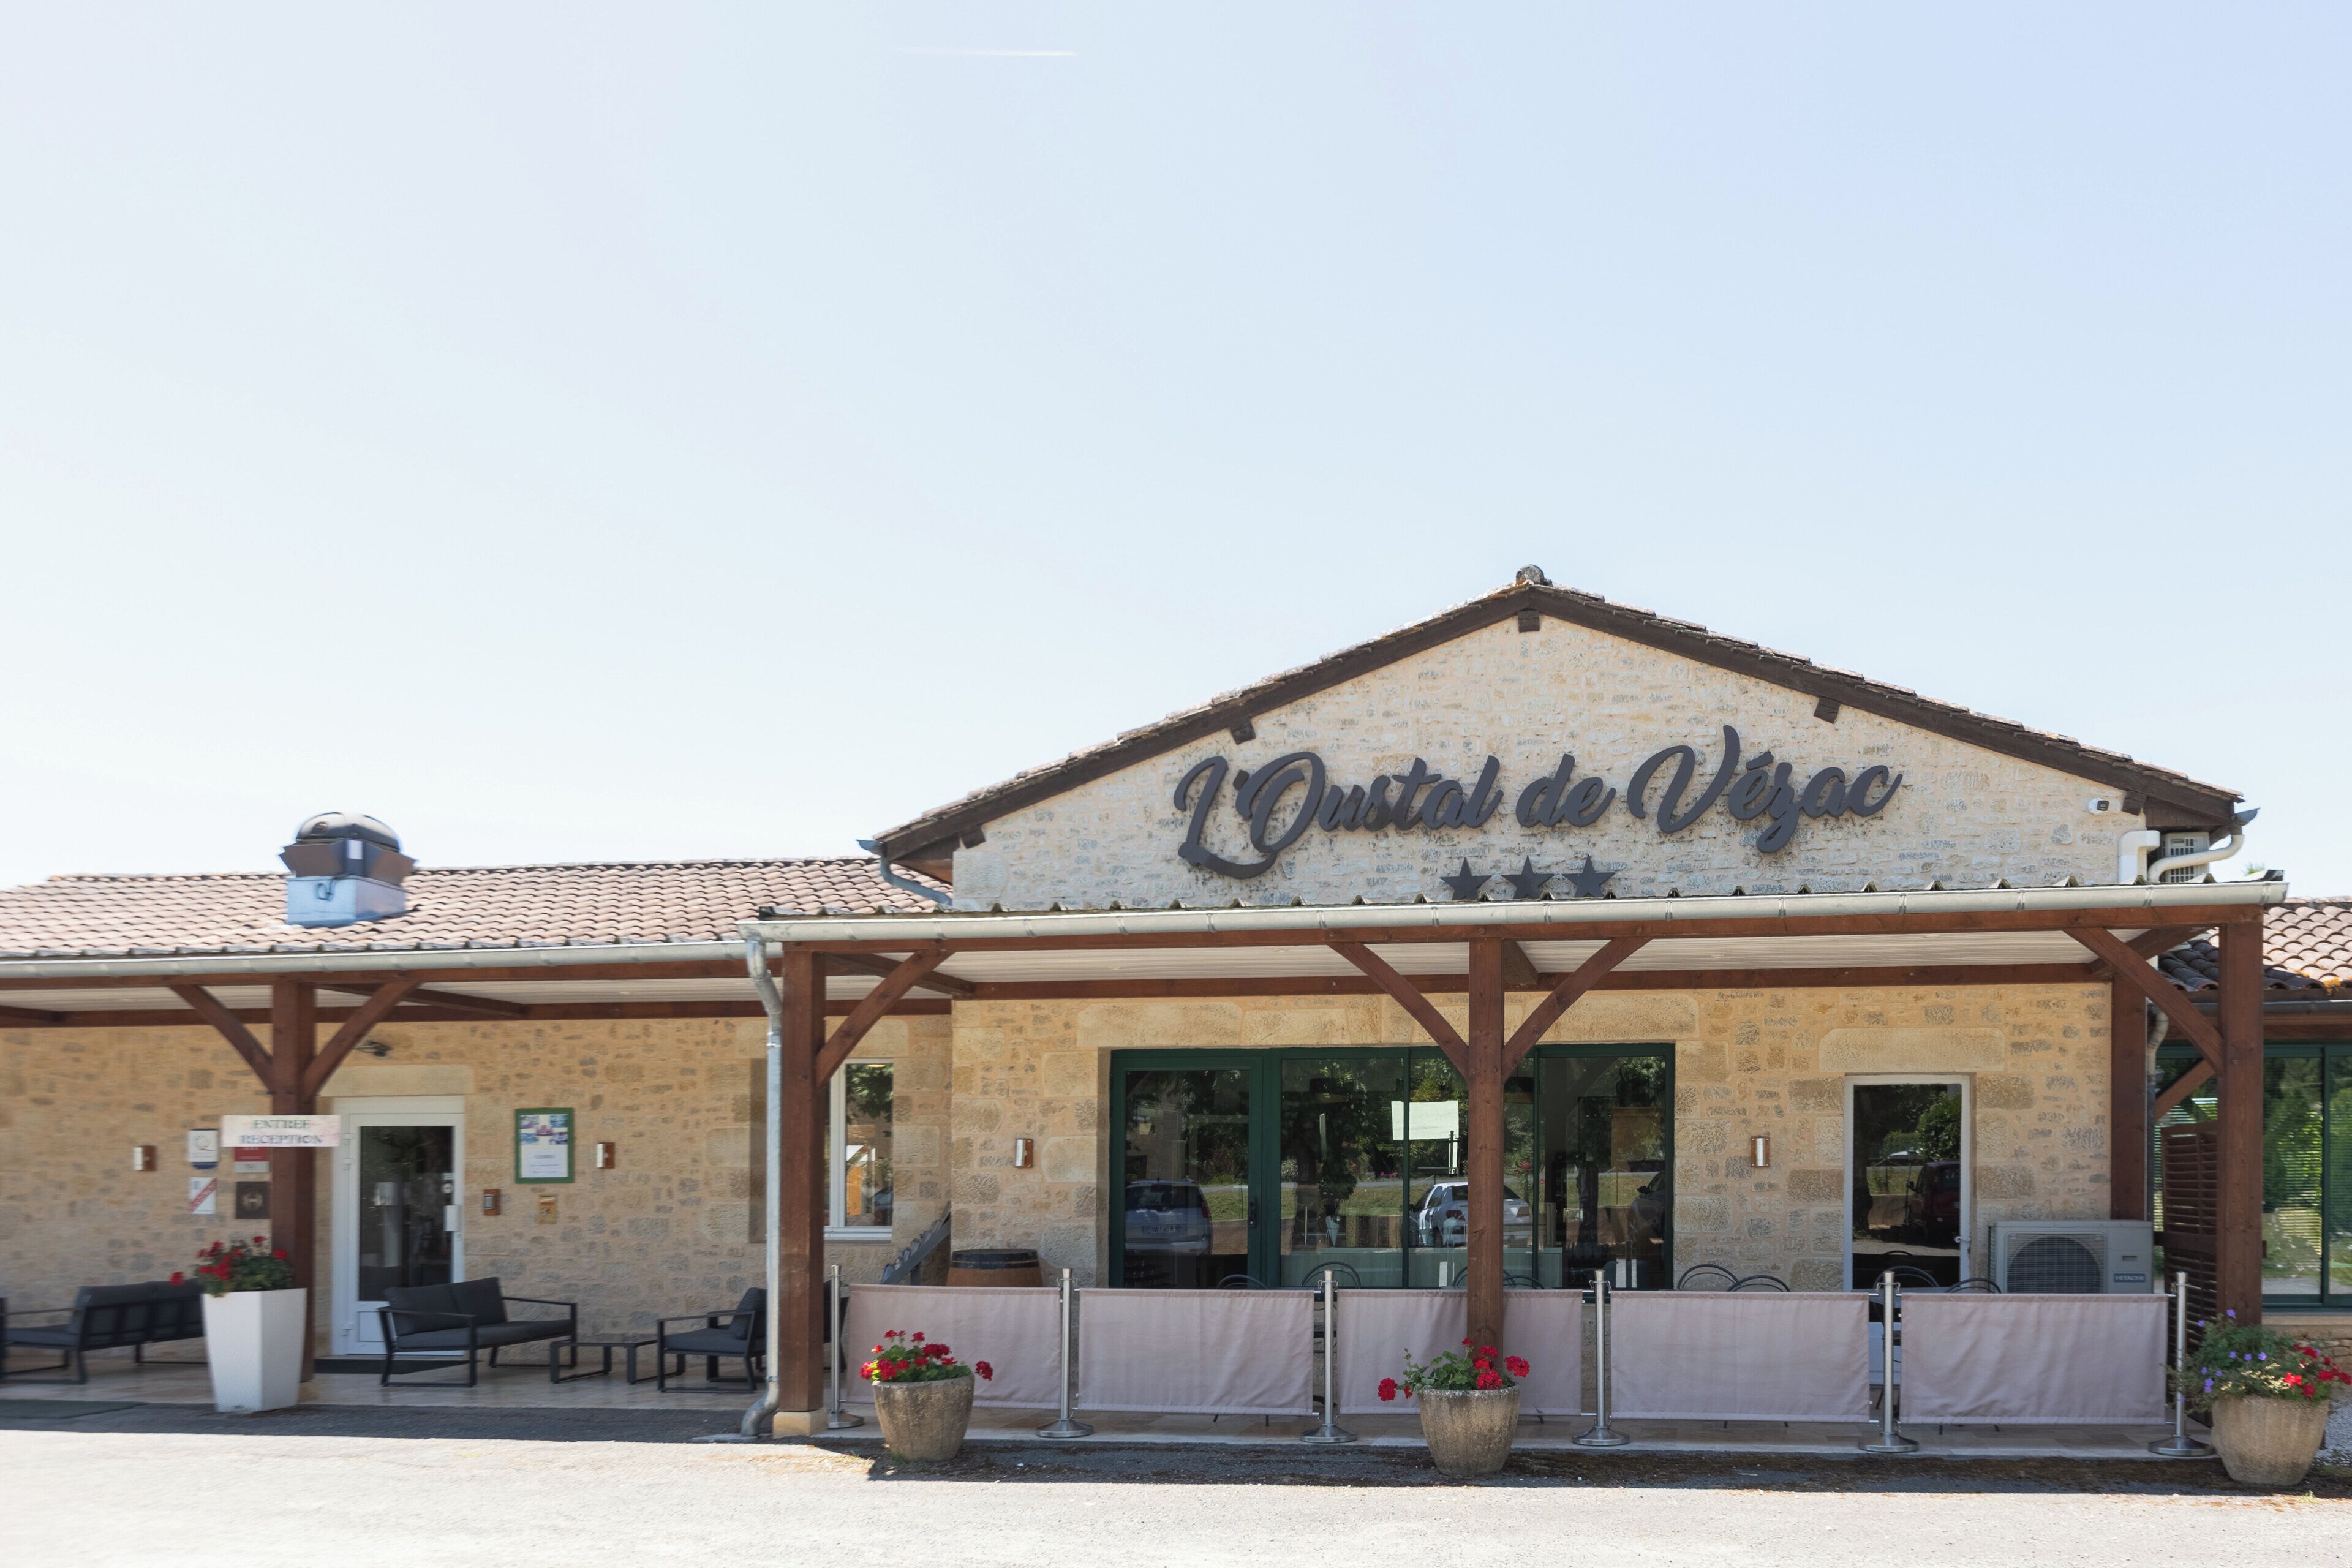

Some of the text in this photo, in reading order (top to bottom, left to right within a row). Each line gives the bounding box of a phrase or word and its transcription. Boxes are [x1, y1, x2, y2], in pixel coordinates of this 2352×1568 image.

[1174, 725, 1903, 880] L'Oustal de Vézac
